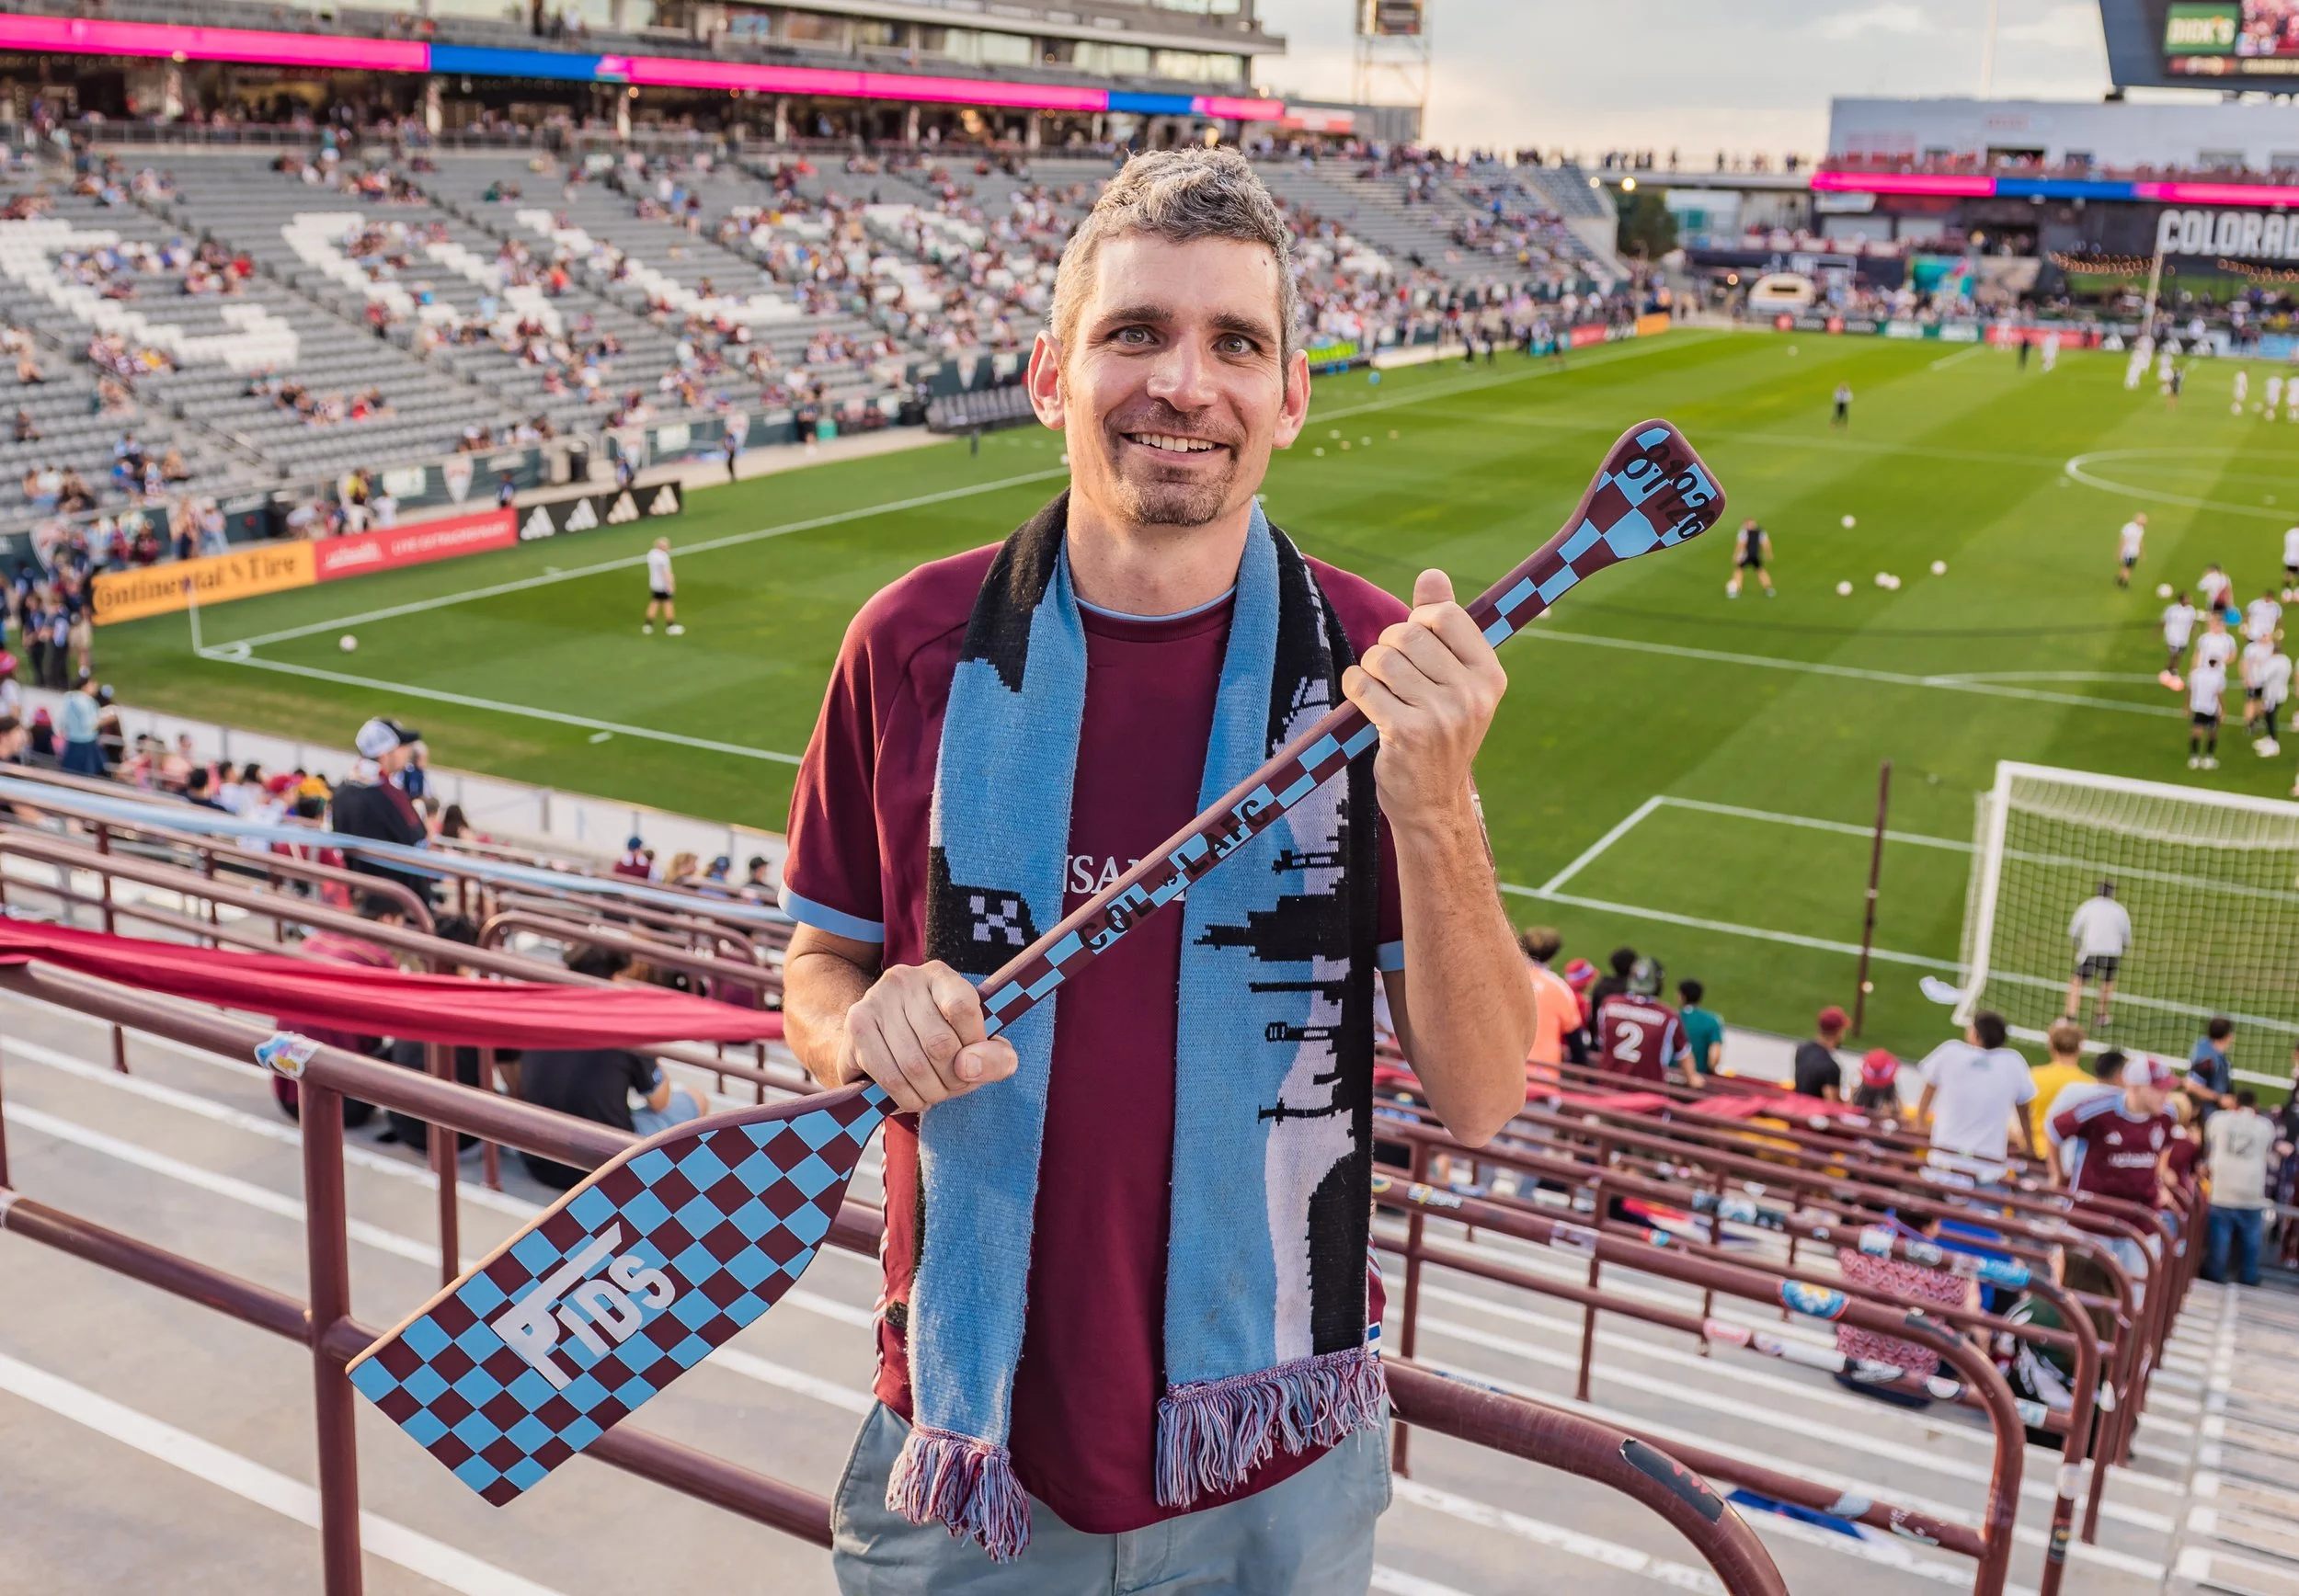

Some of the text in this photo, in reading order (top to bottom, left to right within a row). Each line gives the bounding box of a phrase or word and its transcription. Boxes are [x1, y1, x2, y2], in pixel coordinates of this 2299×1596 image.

[247, 555, 297, 581] Tire
[1077, 894, 1155, 951] COL
[1177, 799, 1271, 876] LAFC
[1613, 1021, 1643, 1063] 2
